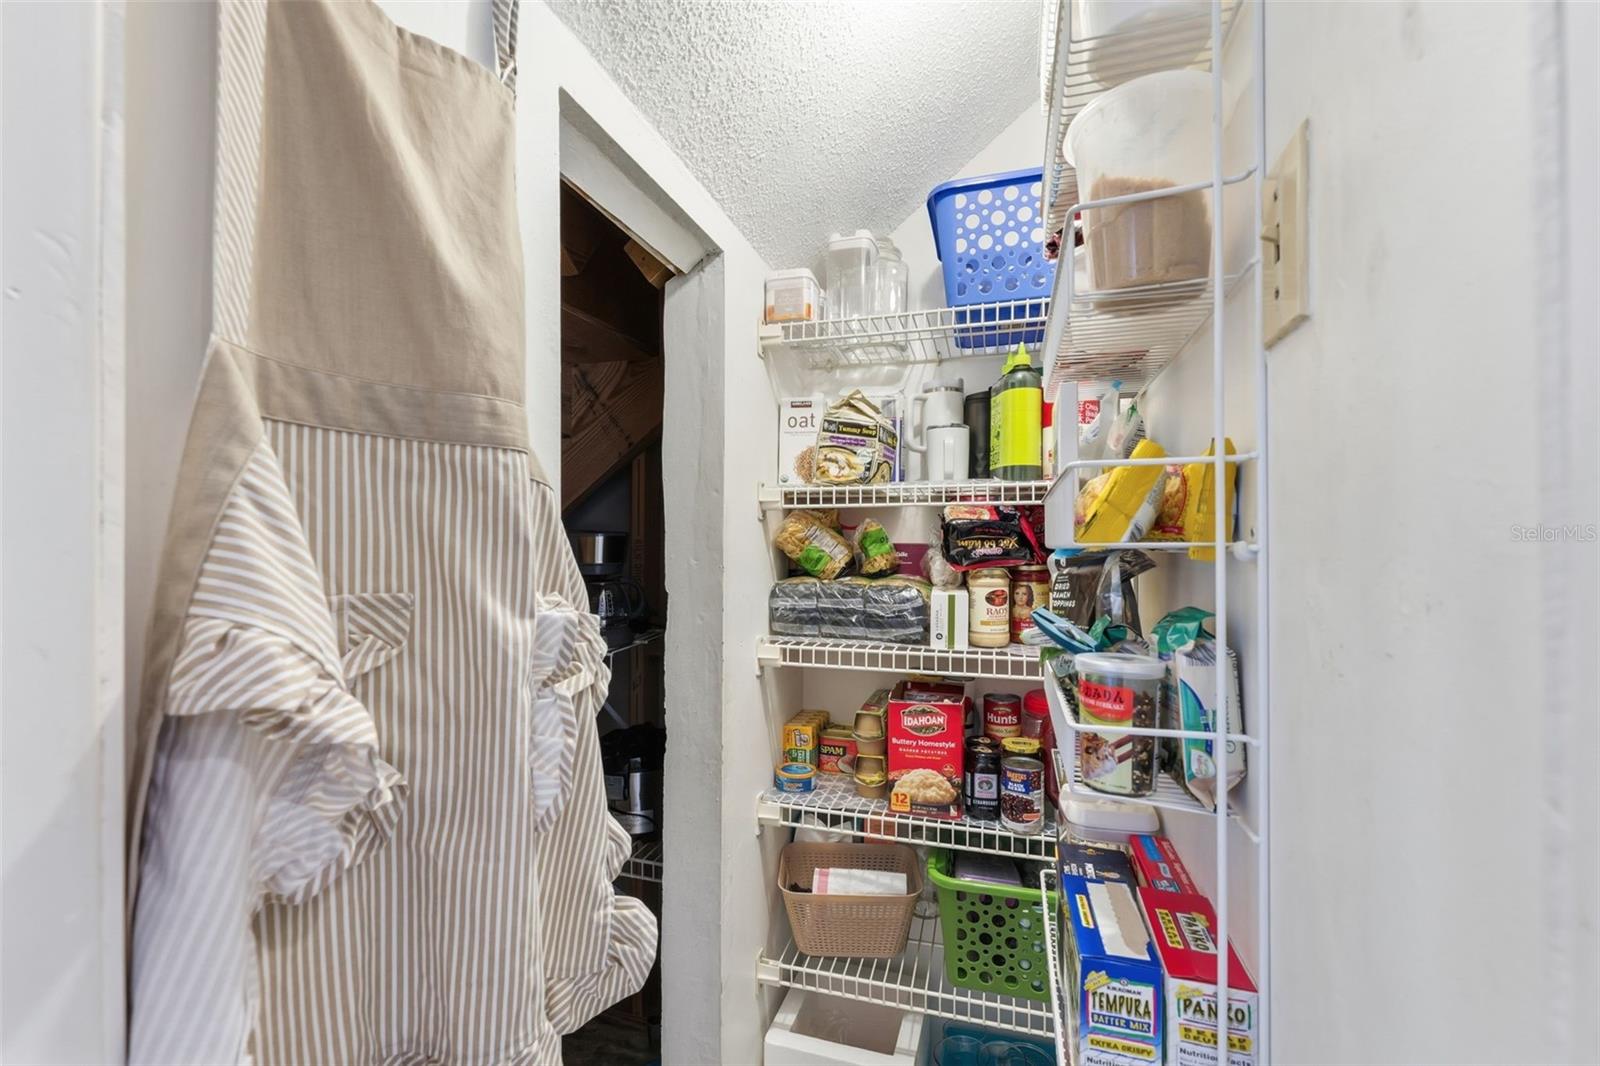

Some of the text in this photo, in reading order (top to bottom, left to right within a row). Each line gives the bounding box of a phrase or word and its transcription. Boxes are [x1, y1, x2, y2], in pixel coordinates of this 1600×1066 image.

[787, 412, 816, 429] oat
[904, 715, 945, 727] IDAHOAN
[820, 744, 844, 756] SPAM
[891, 737, 956, 749] Buttery Homestyle
[893, 793, 909, 804] 12
[1180, 915, 1210, 951] PANKO
[1091, 990, 1152, 1020] TEMPURA
[1093, 1013, 1150, 1033] BATTER MIX
[1090, 1038, 1152, 1057] EXTRA CRISPY
